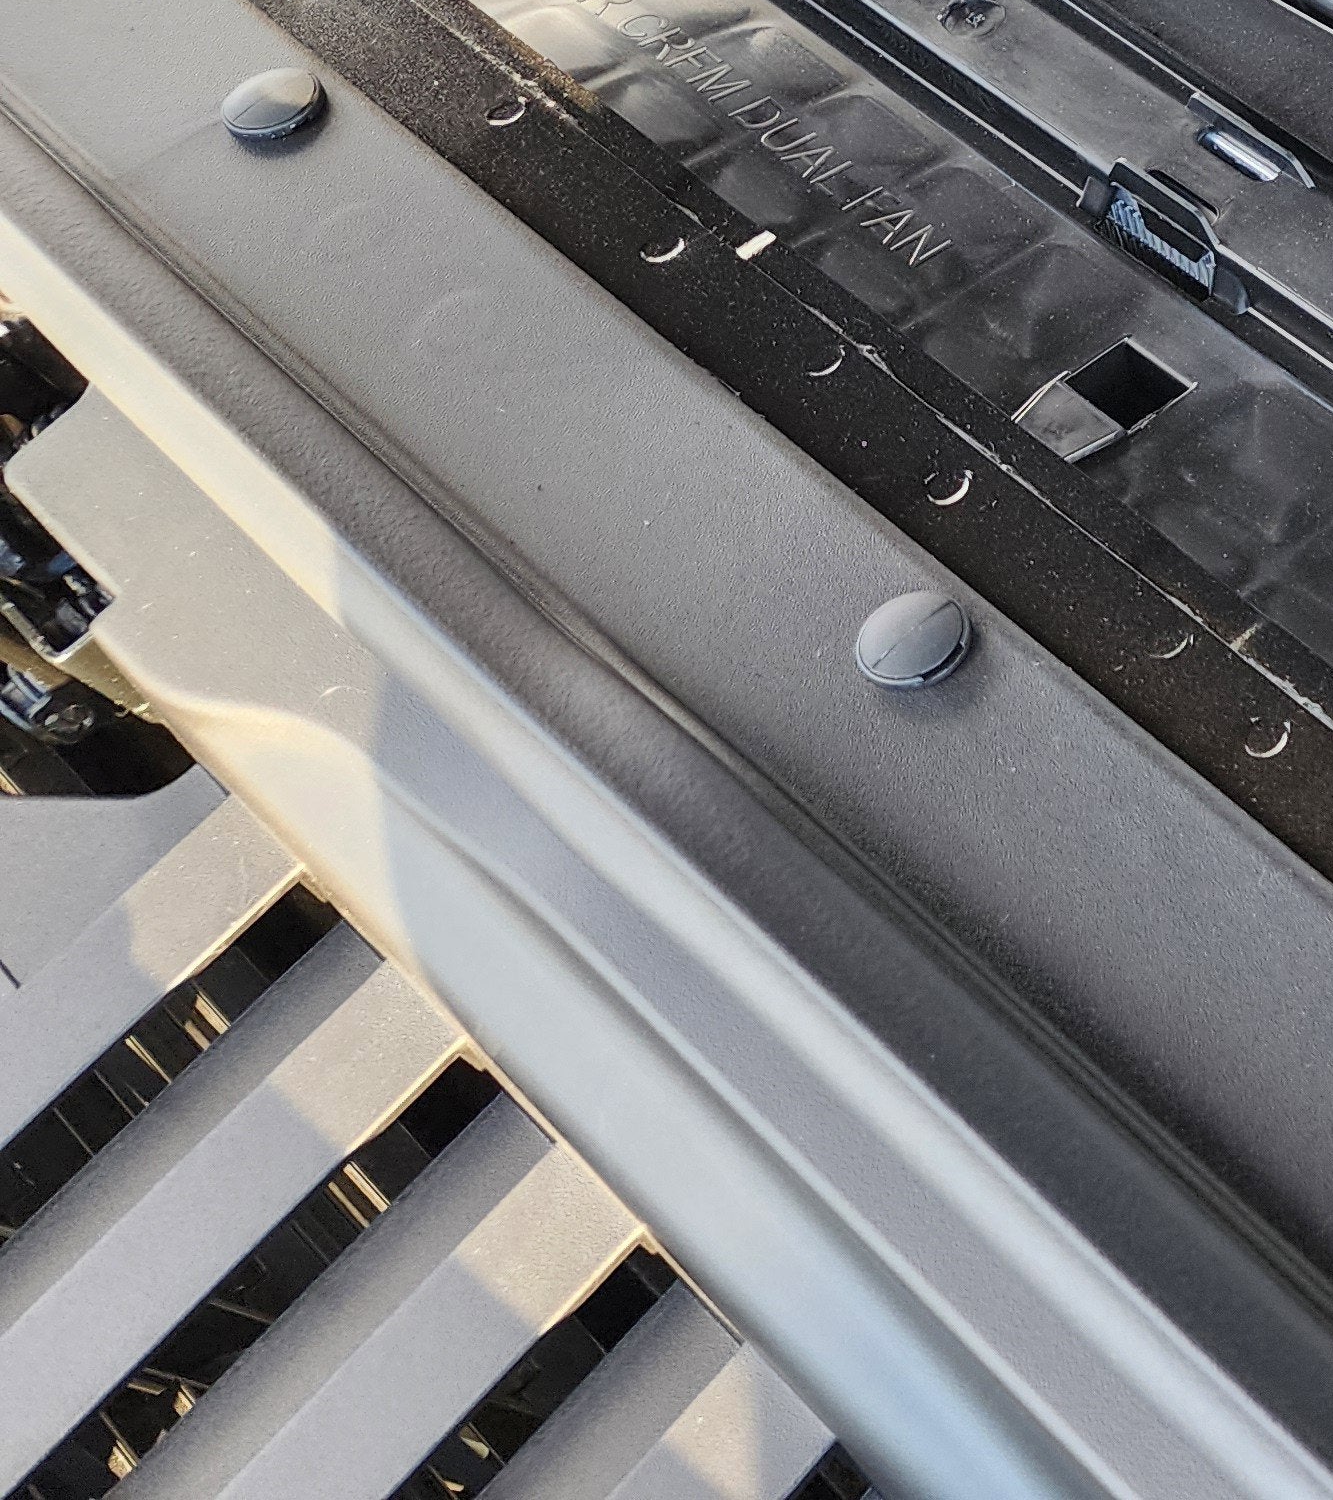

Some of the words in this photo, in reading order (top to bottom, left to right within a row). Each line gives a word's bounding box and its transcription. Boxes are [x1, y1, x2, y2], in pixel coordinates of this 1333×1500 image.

[616, 13, 752, 103] CRFM
[727, 96, 853, 196] DUAL
[841, 186, 952, 267] FAN
